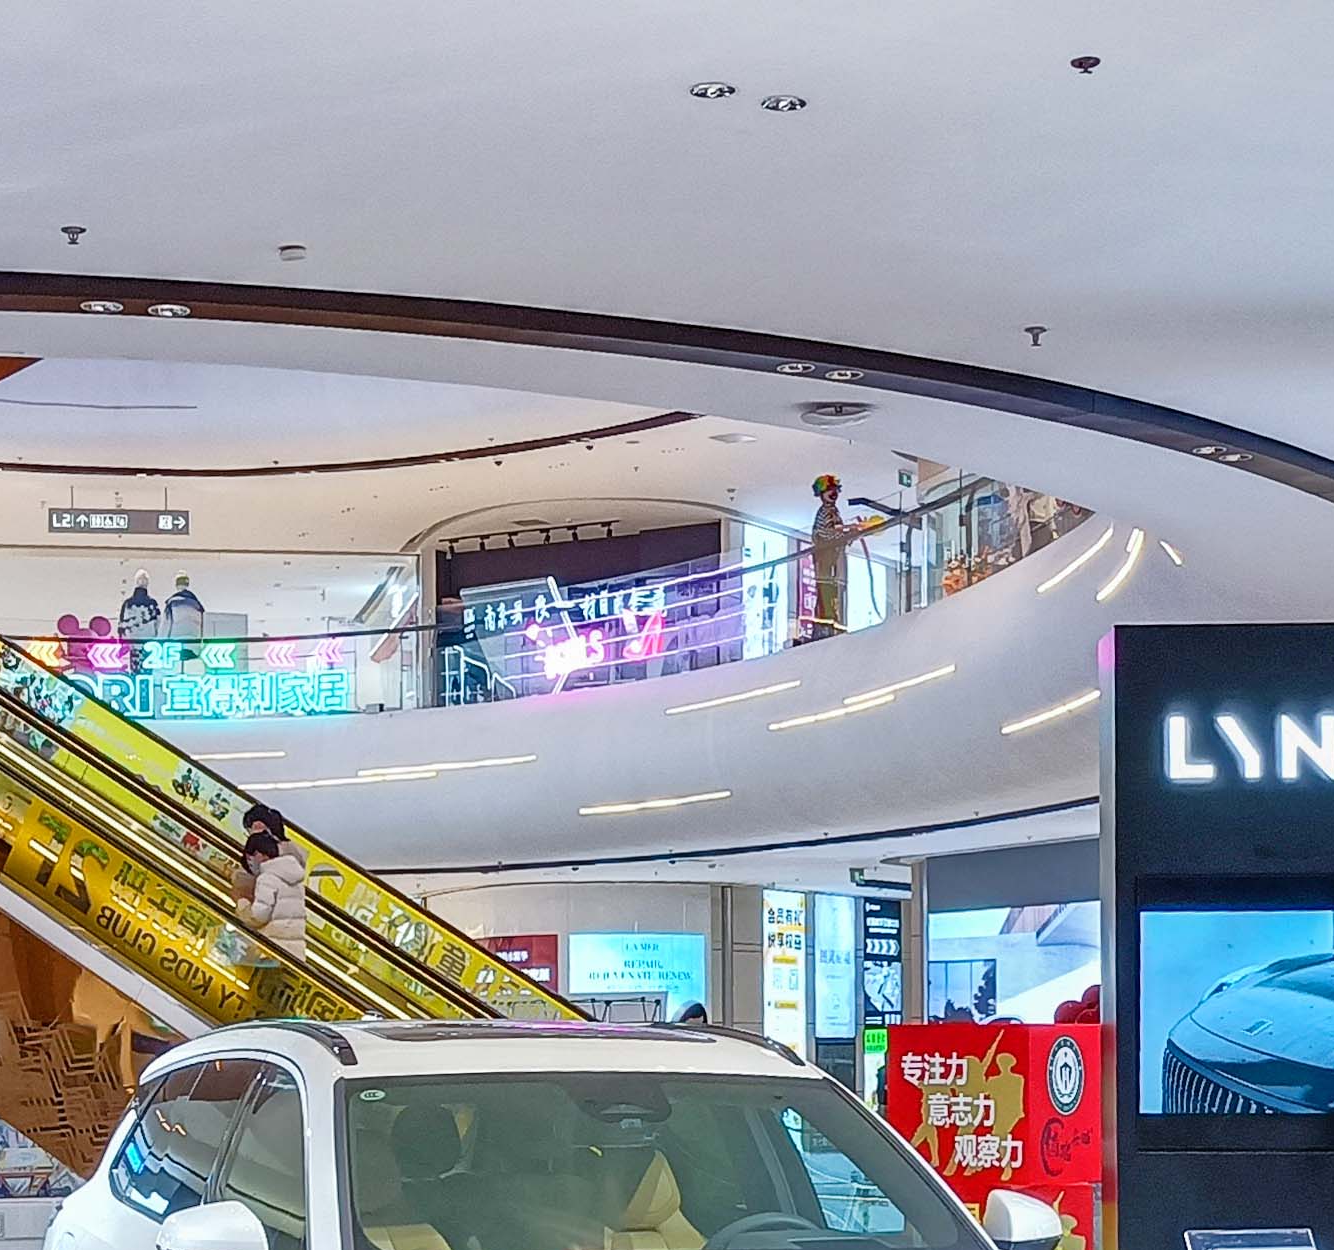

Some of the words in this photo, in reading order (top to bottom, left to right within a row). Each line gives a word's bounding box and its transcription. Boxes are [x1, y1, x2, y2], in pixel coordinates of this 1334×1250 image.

[161, 669, 348, 717] 宜得利家居
[901, 1052, 969, 1086] 专注力
[927, 1094, 996, 1127] 意志力
[953, 1135, 1023, 1169] 观察力
